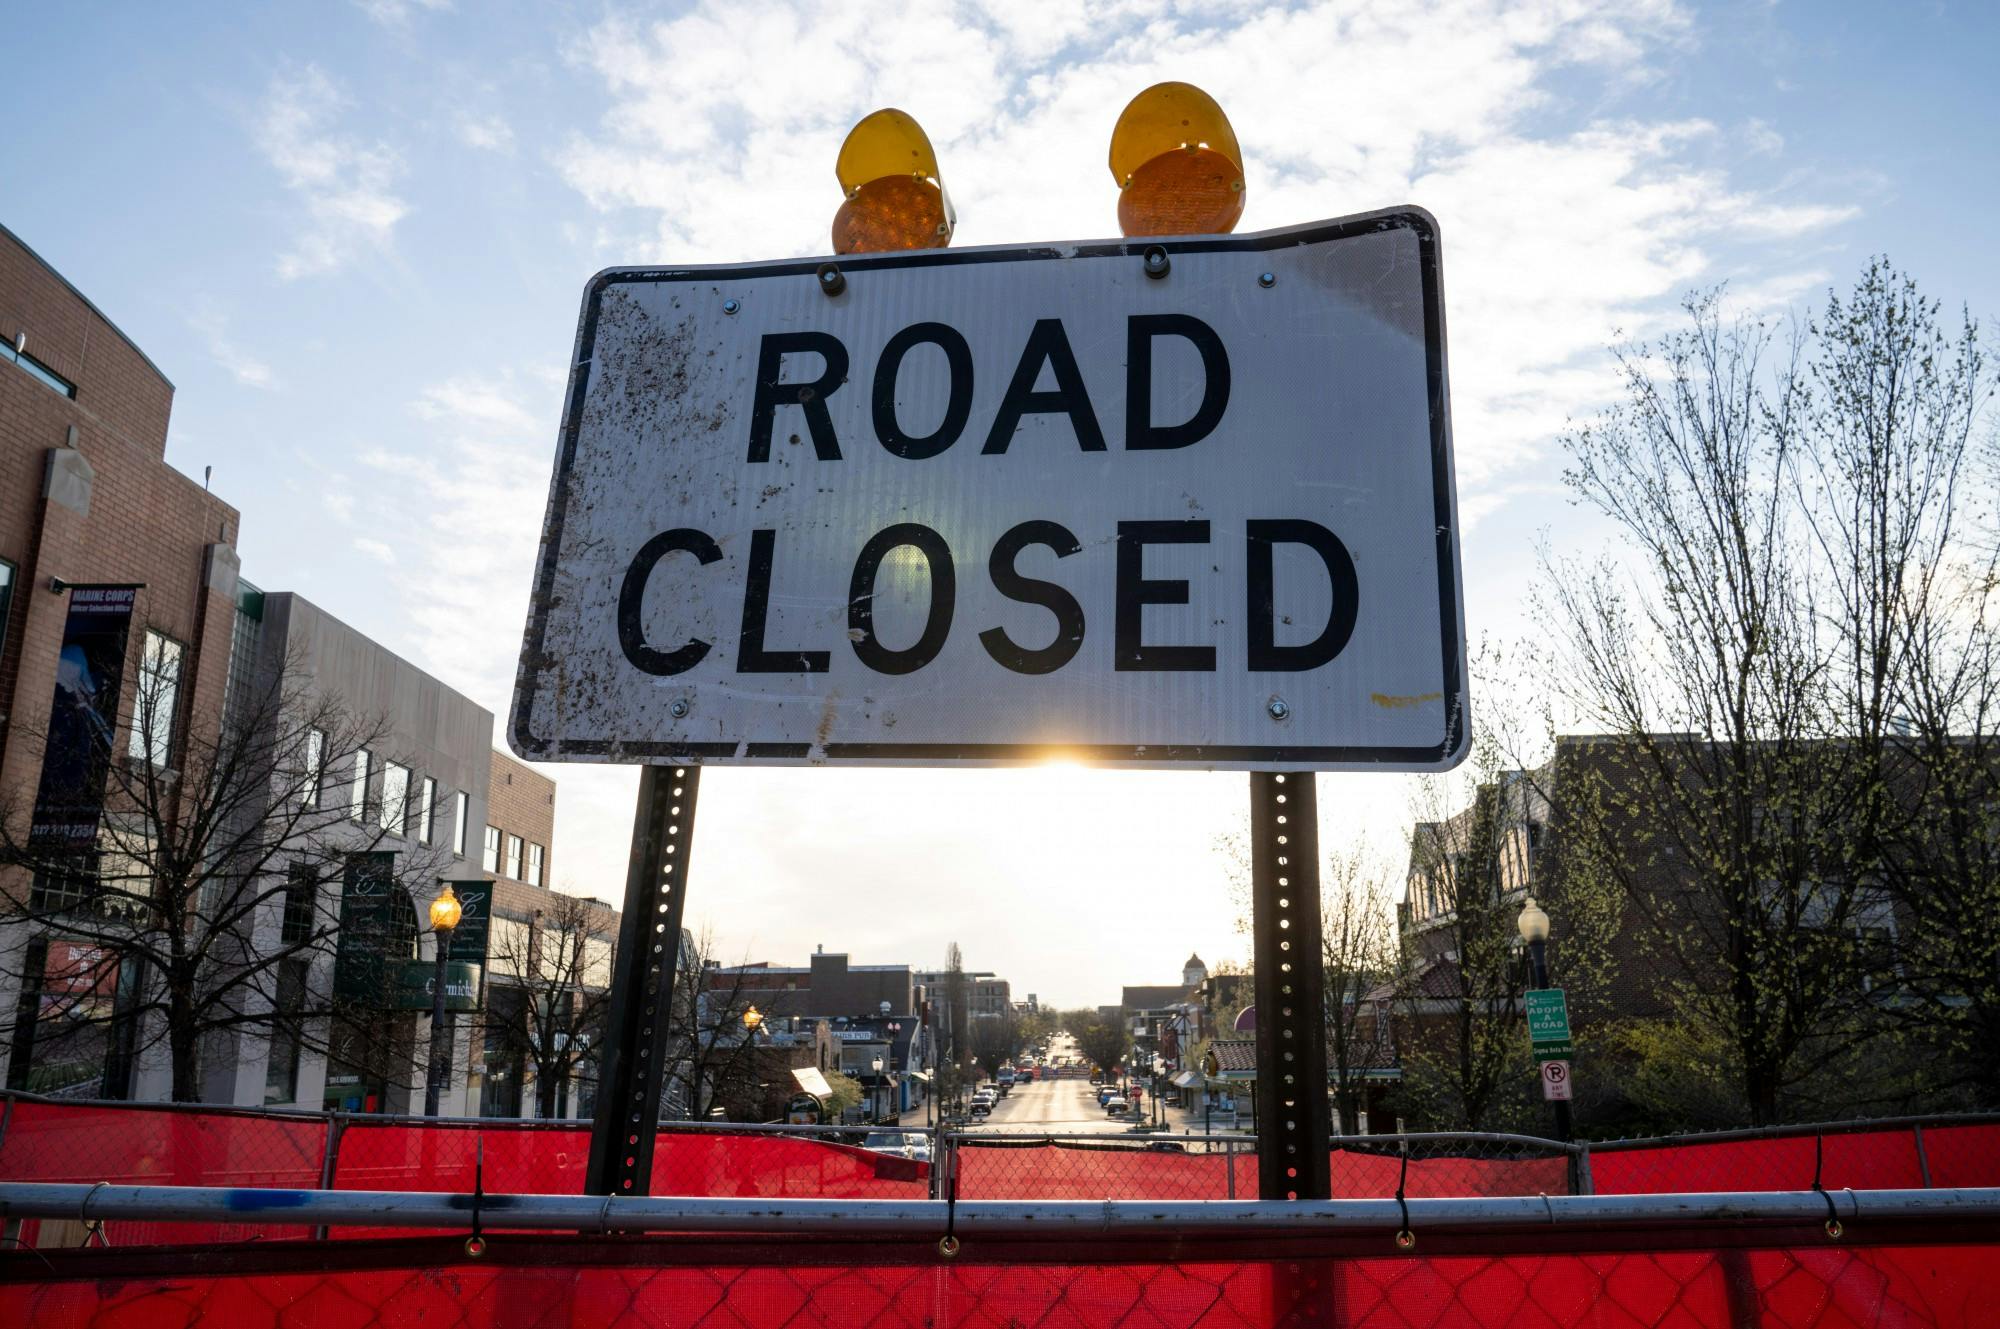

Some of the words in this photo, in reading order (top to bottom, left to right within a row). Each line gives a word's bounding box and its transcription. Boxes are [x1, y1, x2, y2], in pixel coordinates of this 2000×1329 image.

[746, 312, 1231, 463] ROAD
[72, 590, 104, 601] MARINE
[105, 590, 135, 601] CORPS
[617, 518, 1360, 676] CLOSED
[425, 976, 473, 998] Cmich
[1529, 1006, 1564, 1014] ADOPT
[1533, 1021, 1564, 1029] ROAD
